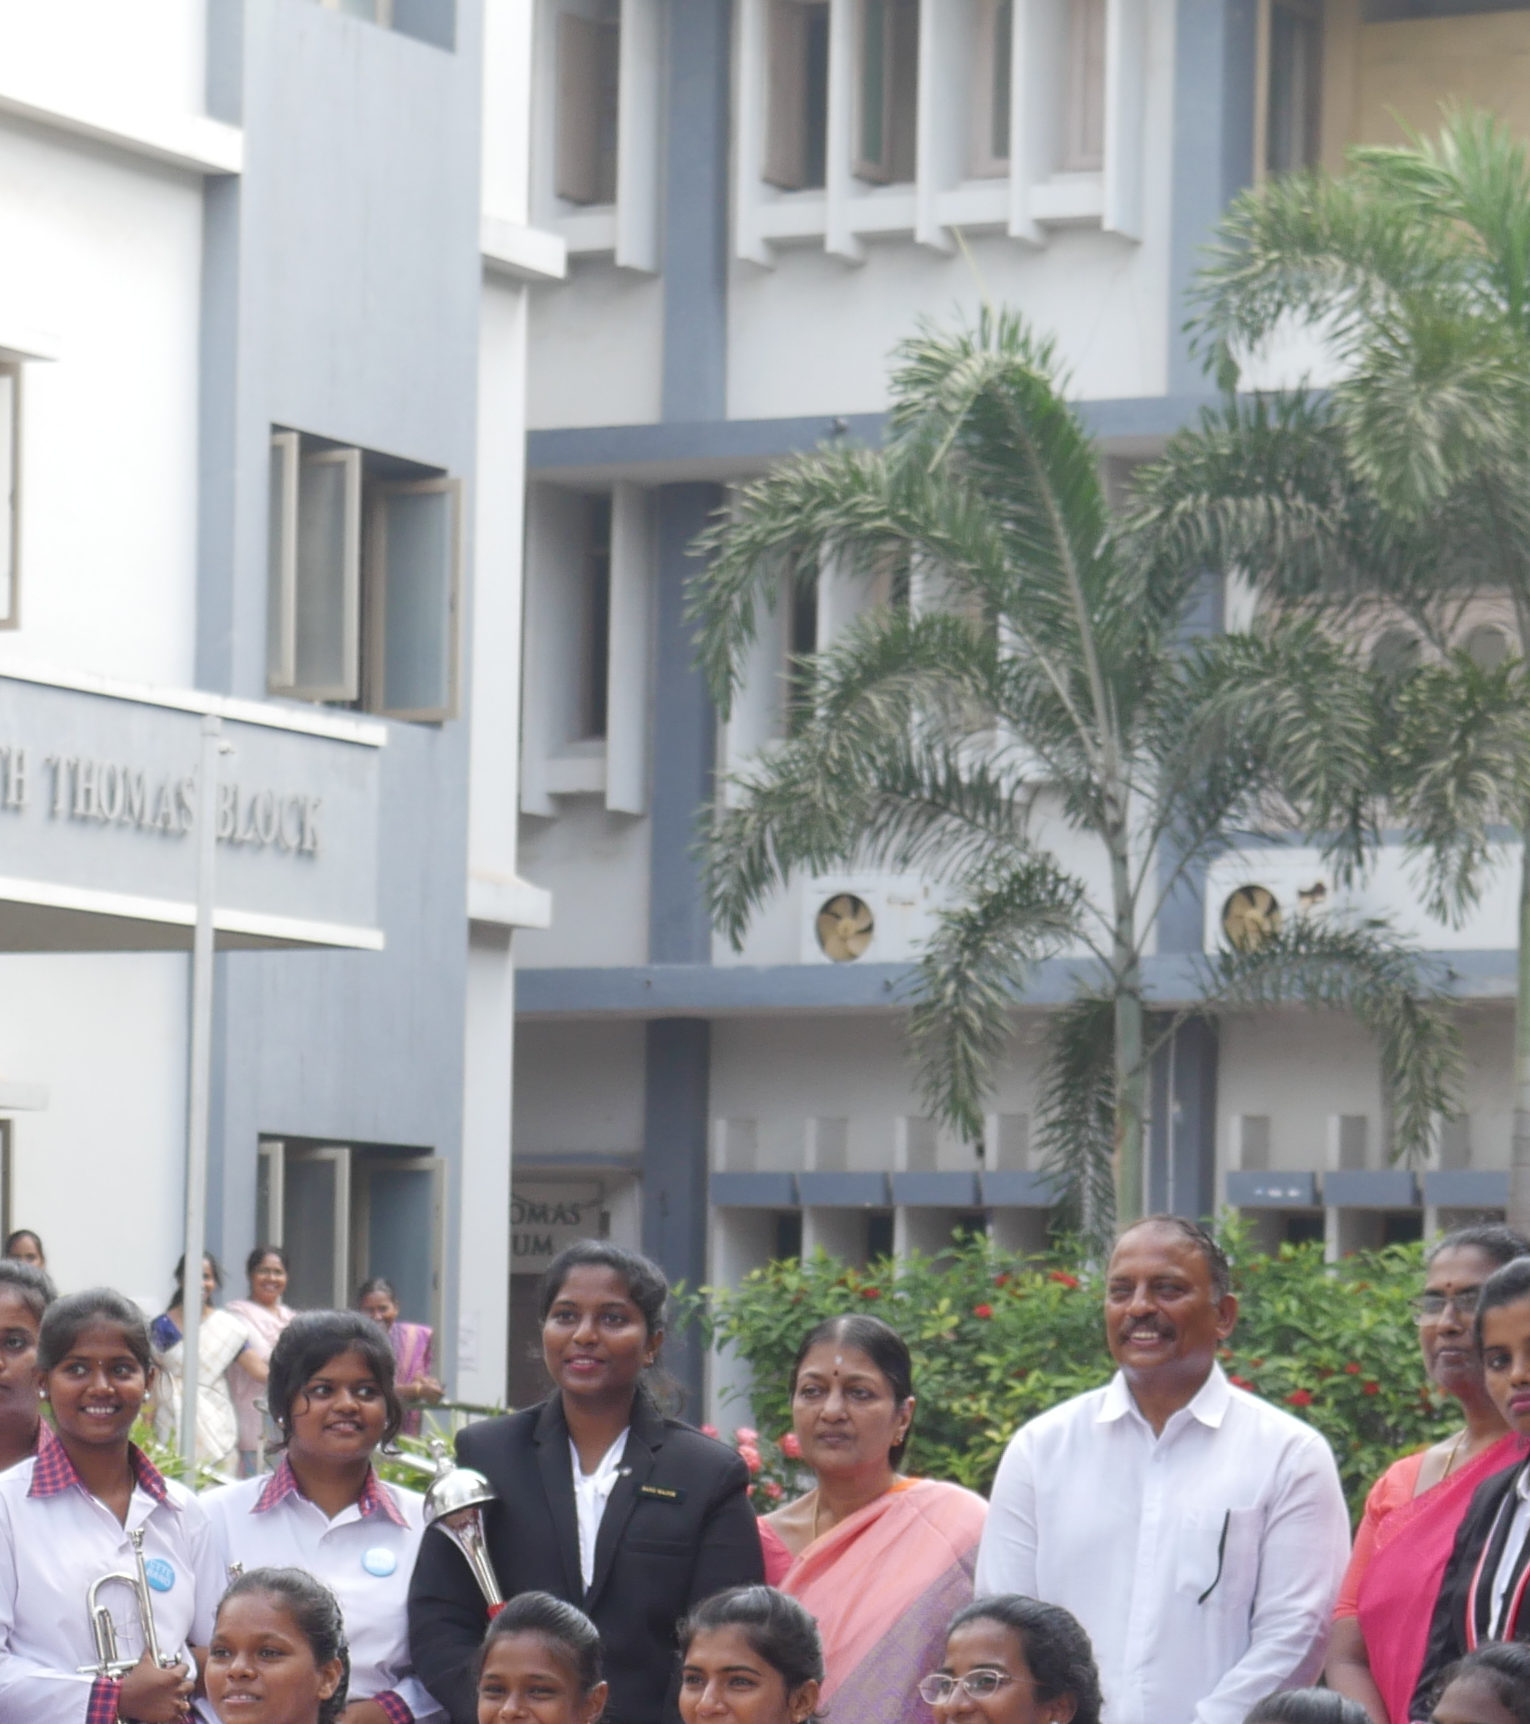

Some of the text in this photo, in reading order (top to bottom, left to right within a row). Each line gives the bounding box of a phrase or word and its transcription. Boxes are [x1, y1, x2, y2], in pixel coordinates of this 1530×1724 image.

[45, 754, 197, 836] THOMAS
[217, 783, 322, 856] BLOCK
[510, 1203, 581, 1225] OMAS
[512, 1234, 553, 1256] UM
